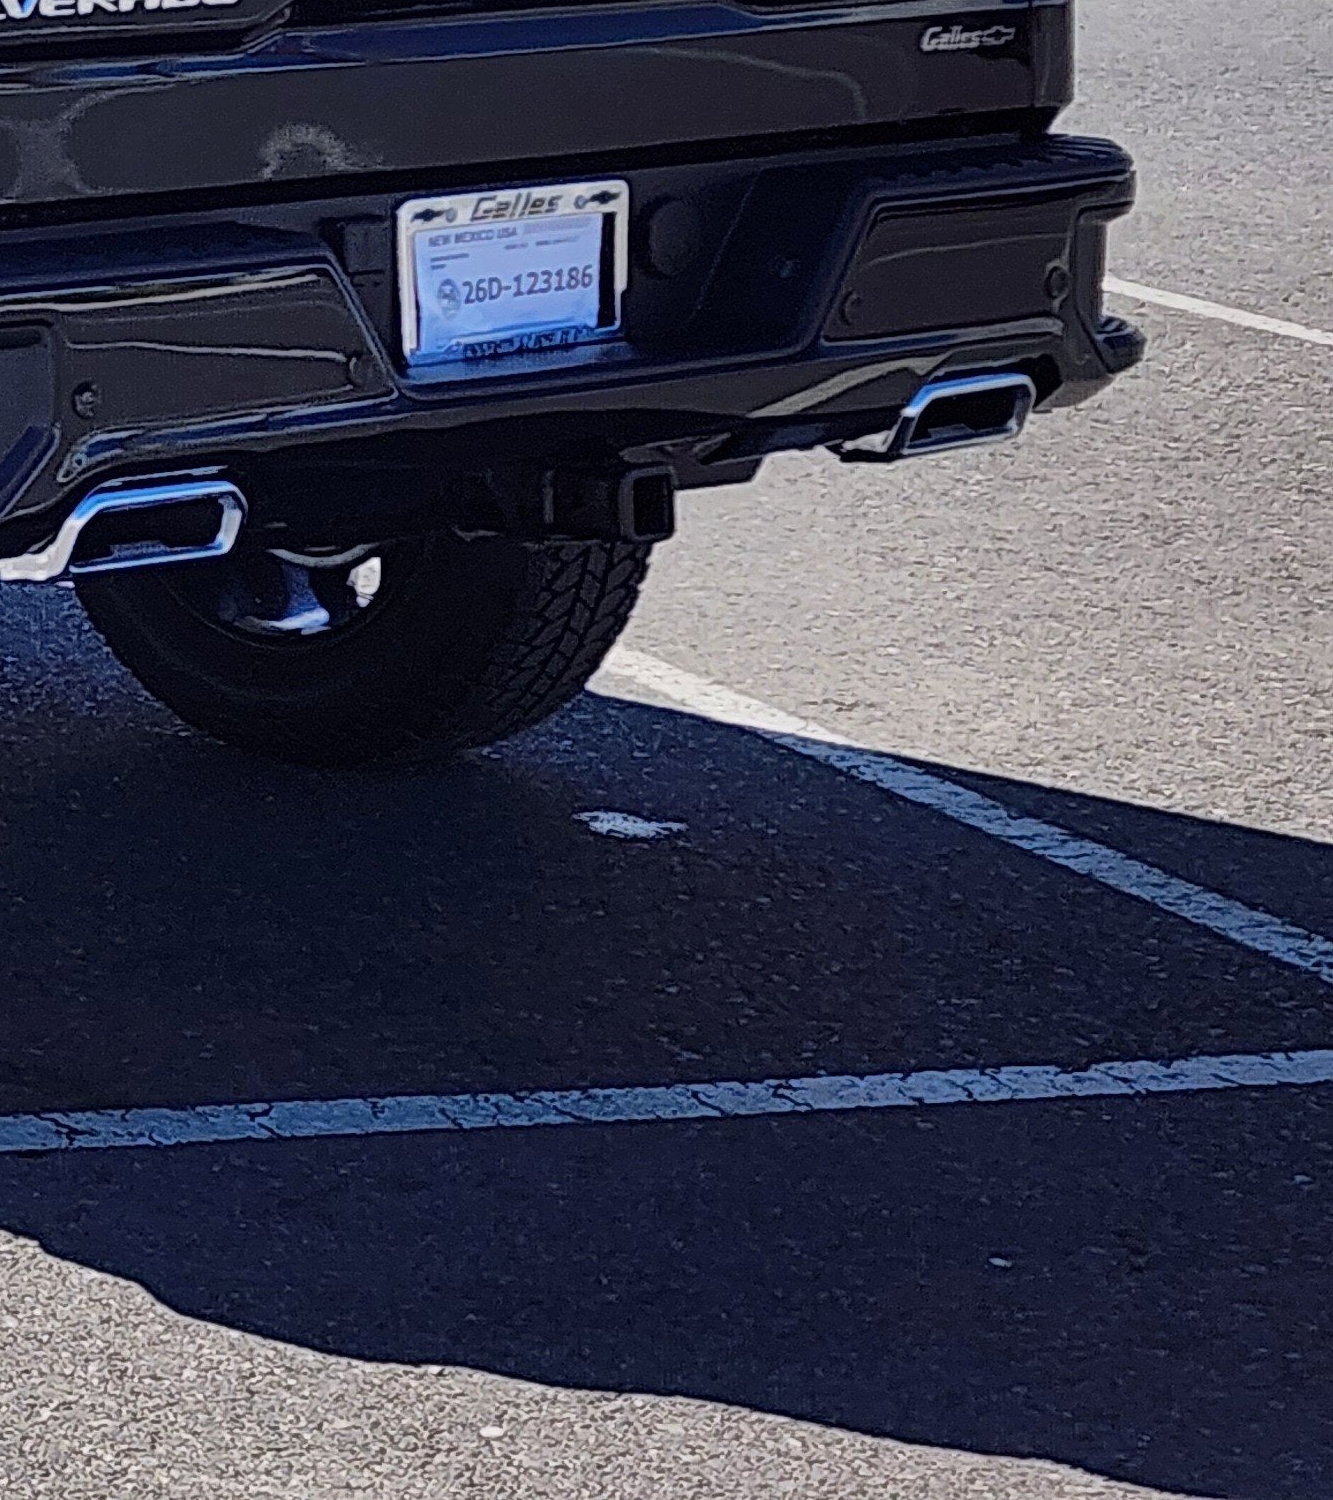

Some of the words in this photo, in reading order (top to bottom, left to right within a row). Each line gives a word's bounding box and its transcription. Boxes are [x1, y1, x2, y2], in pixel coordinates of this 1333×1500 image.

[469, 191, 563, 223] Galles
[427, 234, 452, 248] NEW
[453, 229, 495, 245] MEXICO
[496, 225, 518, 240] USA
[462, 263, 594, 305] 26D-123186
